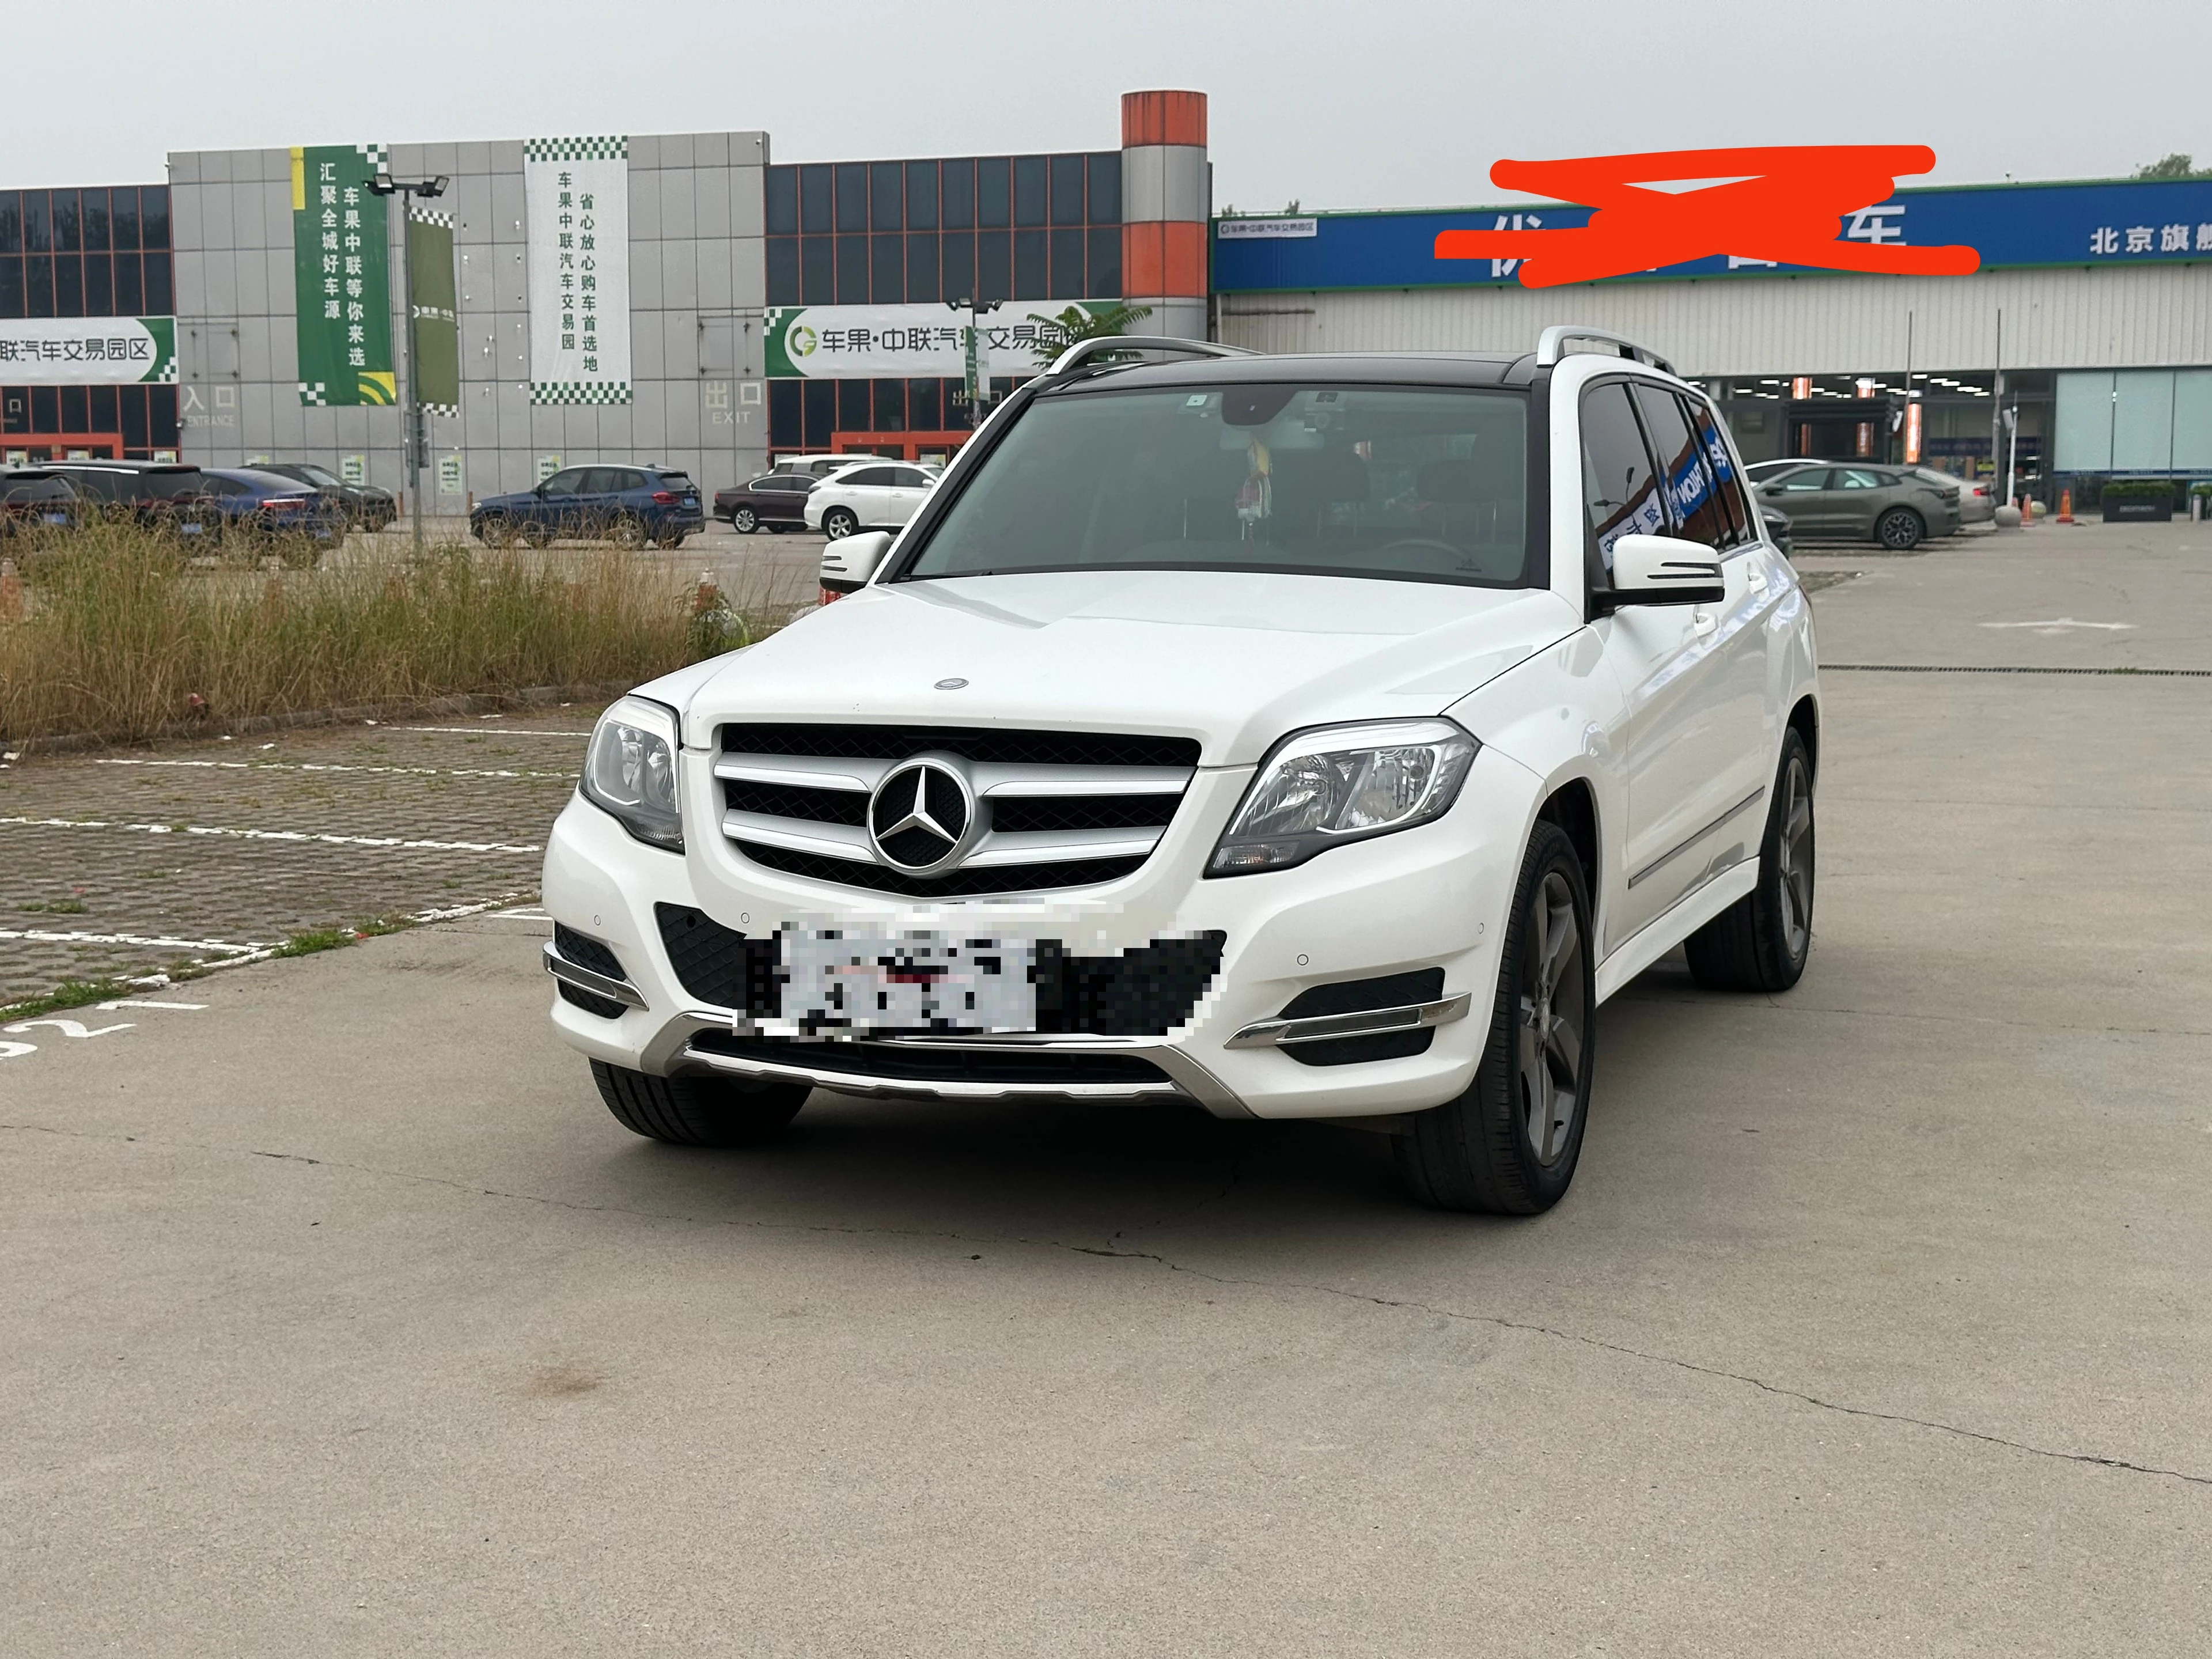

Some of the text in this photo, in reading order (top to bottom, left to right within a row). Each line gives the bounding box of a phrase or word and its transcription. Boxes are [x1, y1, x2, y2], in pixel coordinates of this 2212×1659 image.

[320, 163, 340, 319] 汇聚全城好车源
[344, 187, 365, 366] 车果中联等你来选
[558, 172, 575, 350] 车果中联汽车交易园
[579, 194, 598, 372] 省心放心购车首选地
[183, 386, 235, 412] 入口
[705, 381, 761, 408] 出口
[713, 411, 750, 424] EXIT
